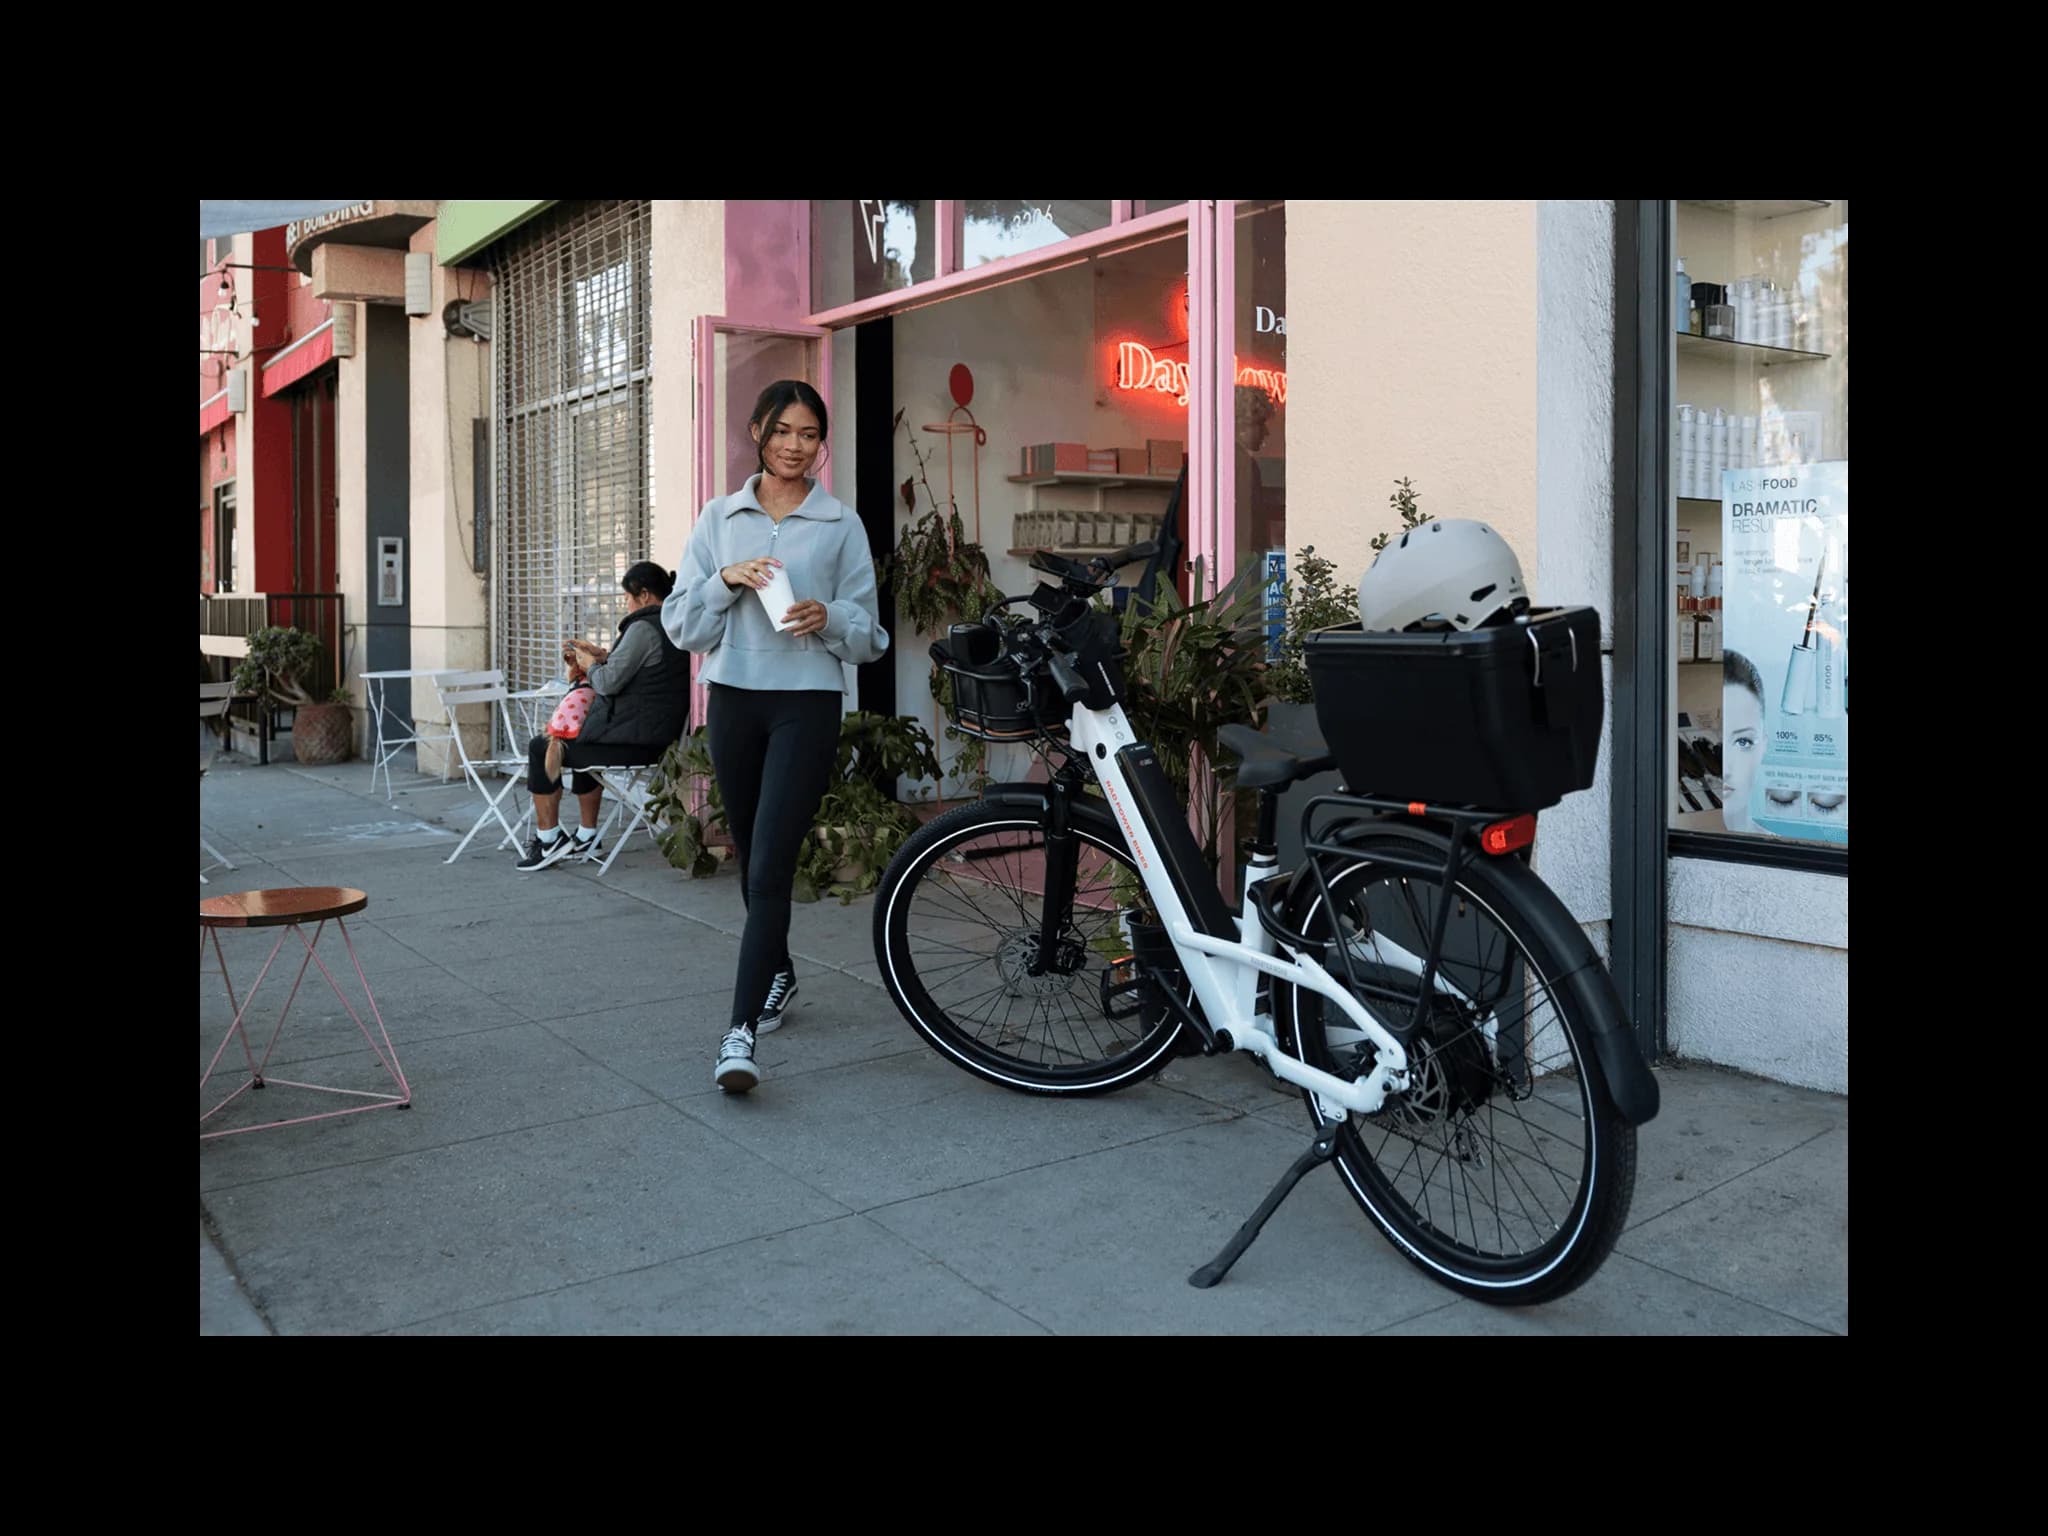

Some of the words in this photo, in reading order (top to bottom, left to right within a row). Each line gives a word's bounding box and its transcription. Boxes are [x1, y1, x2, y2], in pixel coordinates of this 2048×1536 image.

[1256, 306, 1287, 335] Da
[1732, 499, 1817, 517] DRAMATIC
[1776, 731, 1798, 740] 100%
[1106, 780, 1118, 801] RAD
[1116, 802, 1134, 838] POWER
[1133, 839, 1149, 869] BIKES
